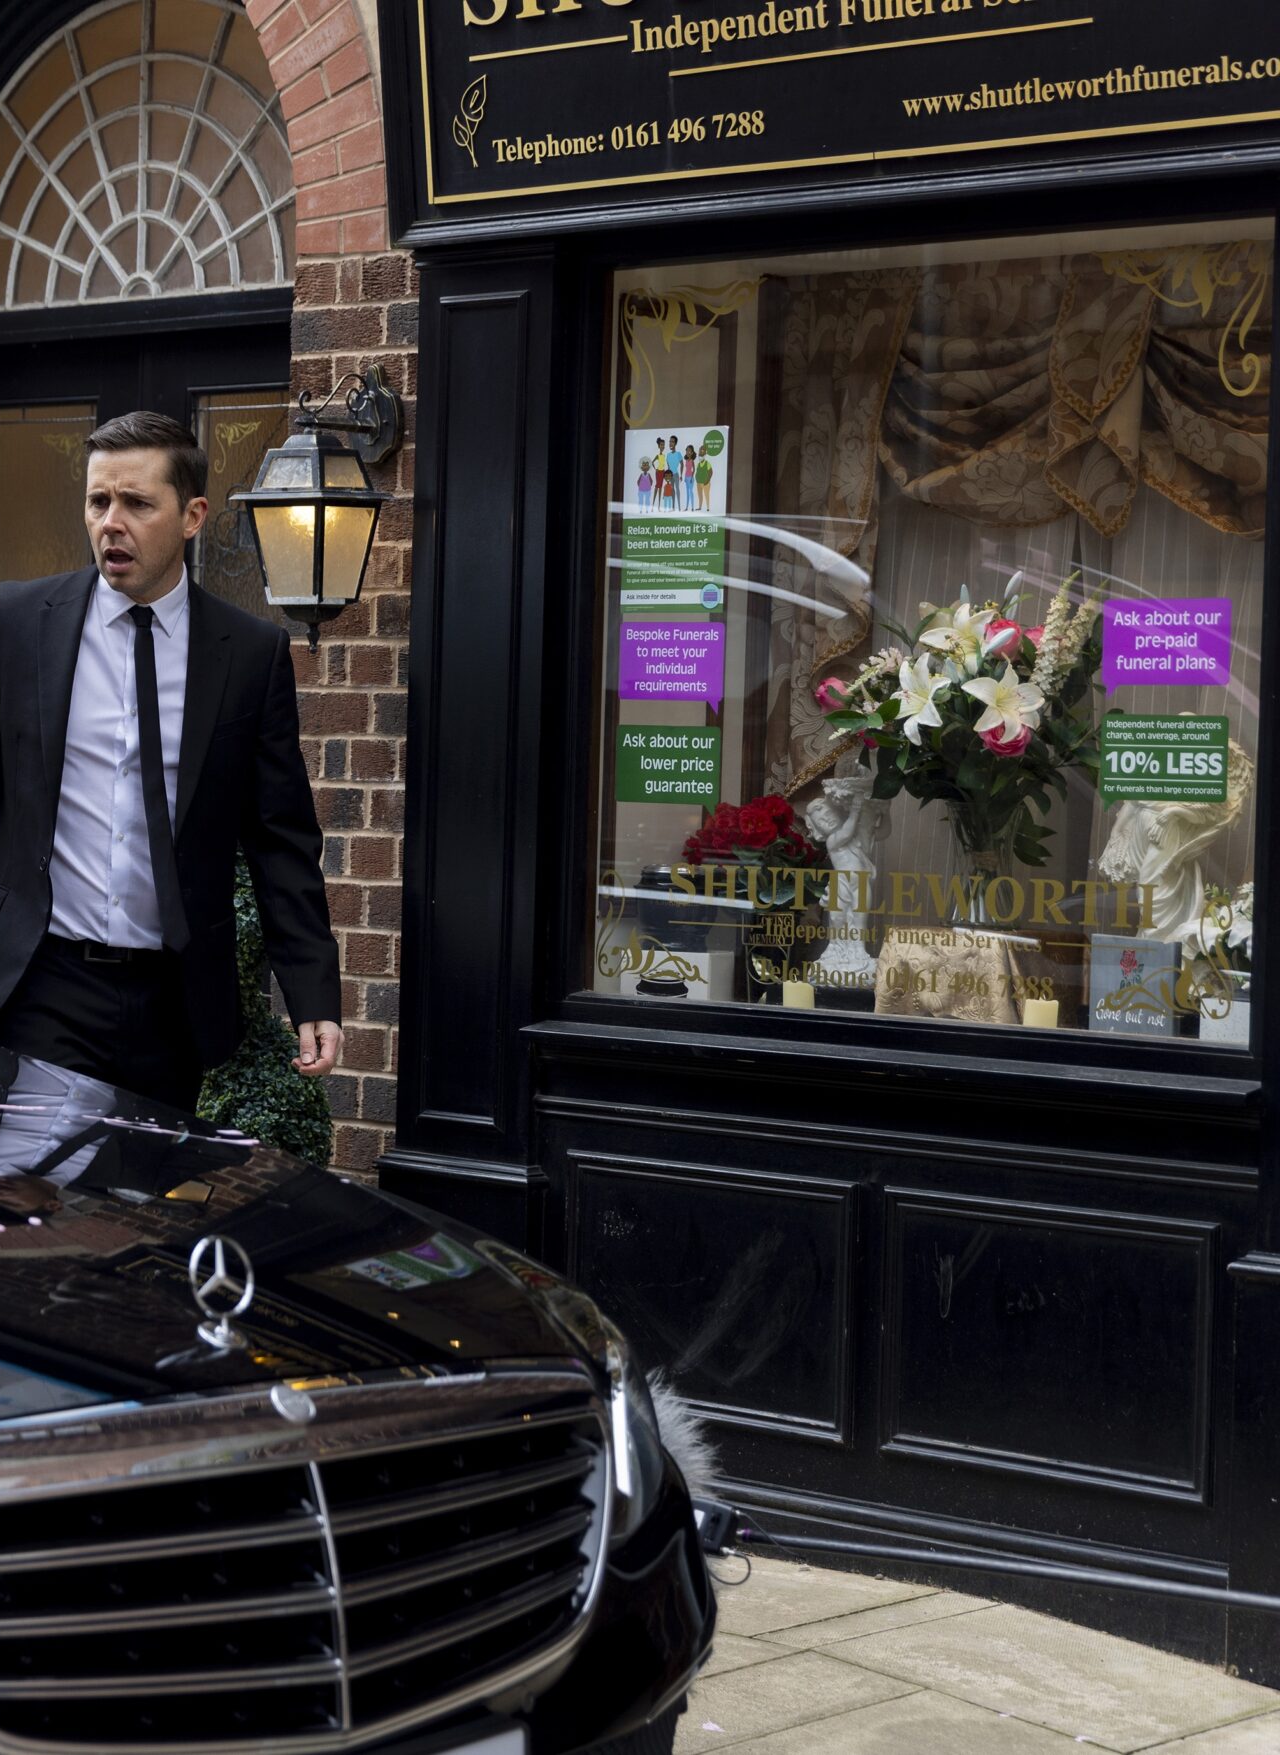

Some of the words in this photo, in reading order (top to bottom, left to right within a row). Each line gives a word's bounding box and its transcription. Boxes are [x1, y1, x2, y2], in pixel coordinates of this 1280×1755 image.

[630, 2, 829, 53] Independent
[903, 56, 1280, 118] www.shuttleworthfunerals.co
[492, 133, 605, 165] Telephone:
[611, 121, 661, 150] 0161
[667, 116, 706, 143] 496
[712, 110, 765, 138] 7288
[627, 526, 652, 536] Relax,
[654, 525, 691, 535] knowing
[693, 524, 706, 533] it's
[707, 523, 718, 533] all
[627, 540, 648, 549] been
[650, 540, 675, 549] taken
[676, 540, 696, 548] care
[698, 539, 708, 547] of
[1113, 611, 1140, 625] Ask
[1144, 611, 1190, 626] about
[1194, 612, 1222, 625] our
[626, 629, 670, 642] Bespoke
[673, 629, 719, 641] Funerals
[1135, 632, 1198, 650] pre-paid
[636, 646, 648, 657] to
[651, 646, 680, 657] meet
[682, 647, 707, 659] your
[645, 662, 697, 675] individual
[1116, 655, 1171, 670] funeral
[1175, 655, 1216, 672] plans
[634, 679, 707, 693] requirements
[1106, 720, 1155, 730] Independent
[1156, 720, 1184, 729] funeral
[1186, 720, 1221, 730] directors
[622, 733, 646, 748] Ask
[649, 734, 688, 748] about
[691, 737, 715, 749] our
[1106, 731, 1134, 741] charge,
[1147, 732, 1180, 741] average,
[1181, 732, 1210, 740] around
[640, 755, 678, 770] lower
[681, 757, 714, 773] price
[1105, 751, 1160, 774] 10%
[1166, 751, 1223, 776] LESS
[645, 779, 714, 794] guarantee
[1104, 784, 1115, 792] for
[1116, 784, 1144, 793] funerals
[1146, 785, 1162, 793] than
[1164, 785, 1181, 794] large
[1183, 786, 1222, 795] corporates
[669, 862, 1159, 929] SHUTTLEWORTH
[765, 916, 876, 944] Independent
[884, 925, 957, 948] Funeral
[885, 967, 939, 994] 0161
[947, 971, 990, 996] 496
[998, 974, 1054, 1001] 7288
[1125, 1003, 1143, 1025] but
[1147, 1009, 1167, 1028] not
